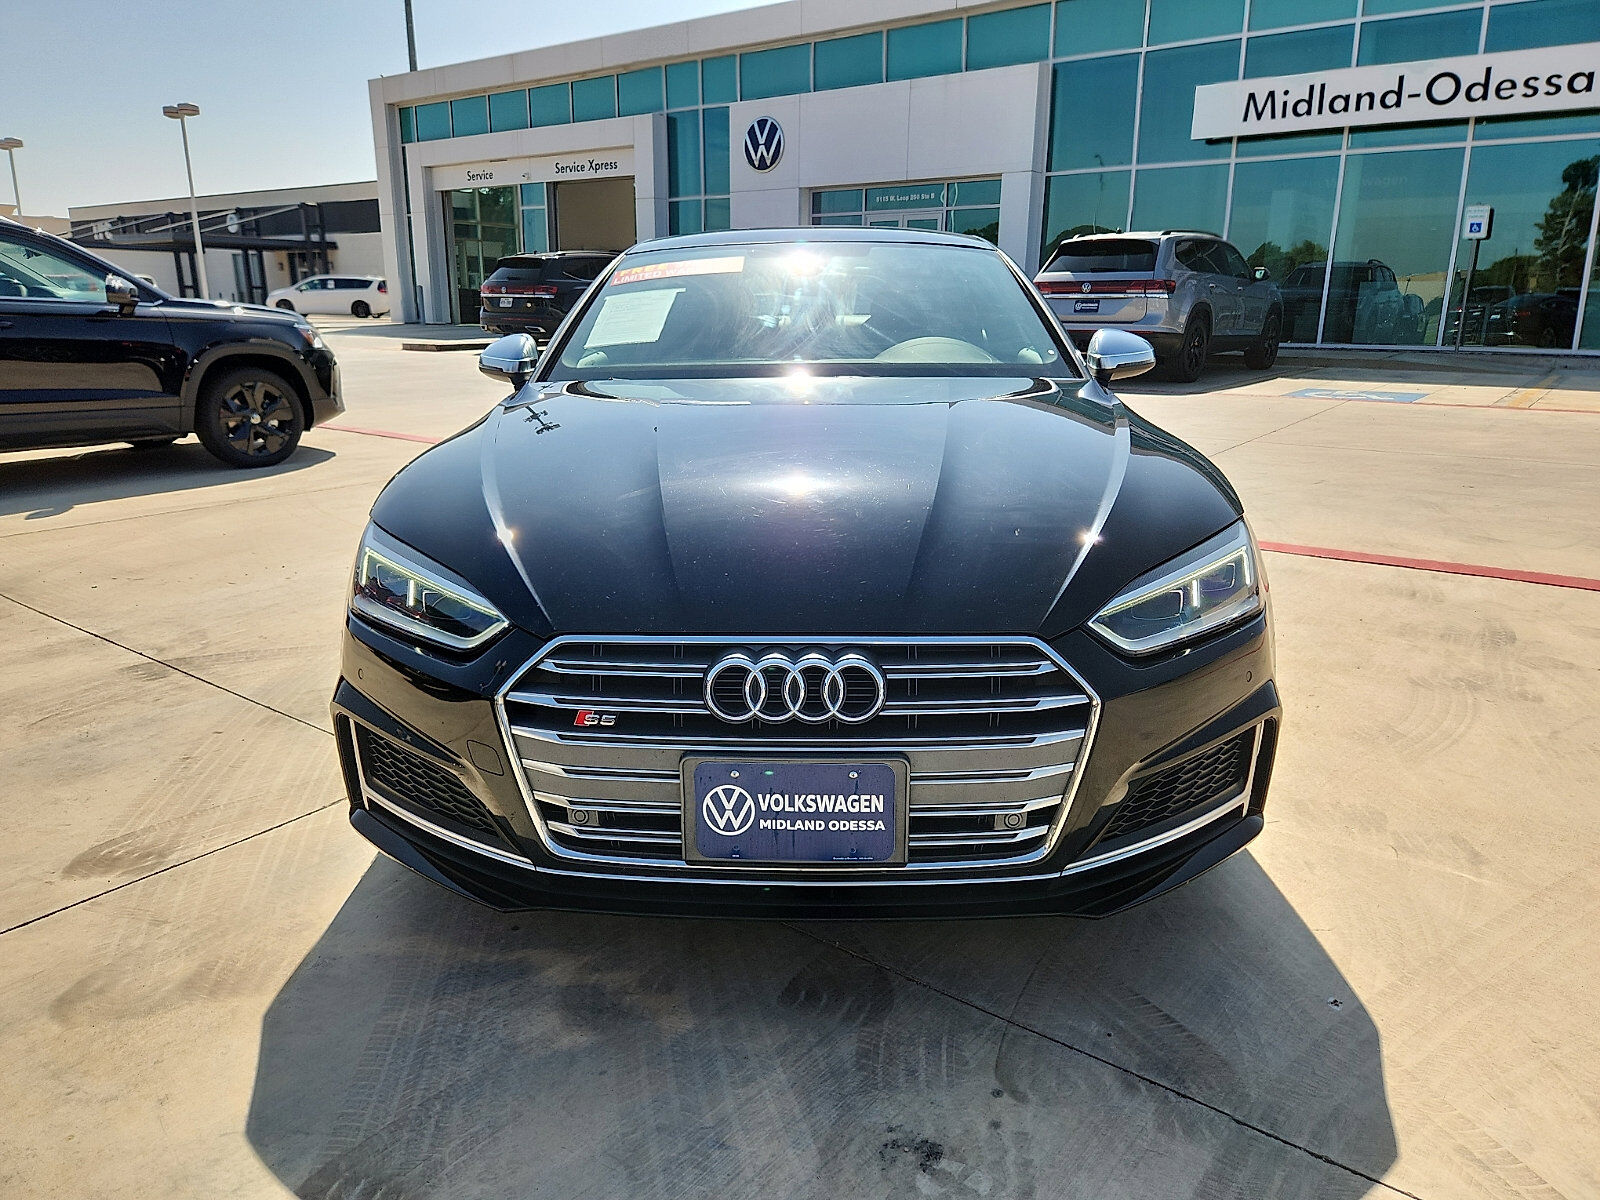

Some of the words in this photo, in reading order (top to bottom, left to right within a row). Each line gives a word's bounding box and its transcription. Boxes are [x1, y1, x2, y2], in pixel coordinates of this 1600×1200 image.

[1242, 67, 1596, 122] Midland-Odessa
[555, 162, 586, 174] Service
[588, 159, 618, 174] Xpress
[467, 170, 494, 182] Service
[614, 271, 662, 285] LIMITED
[584, 714, 616, 726] S5
[705, 786, 753, 833] VW
[757, 793, 884, 813] VOLKSWAGEN
[759, 819, 825, 831] MIDLAND
[828, 820, 886, 831] ODESSA
